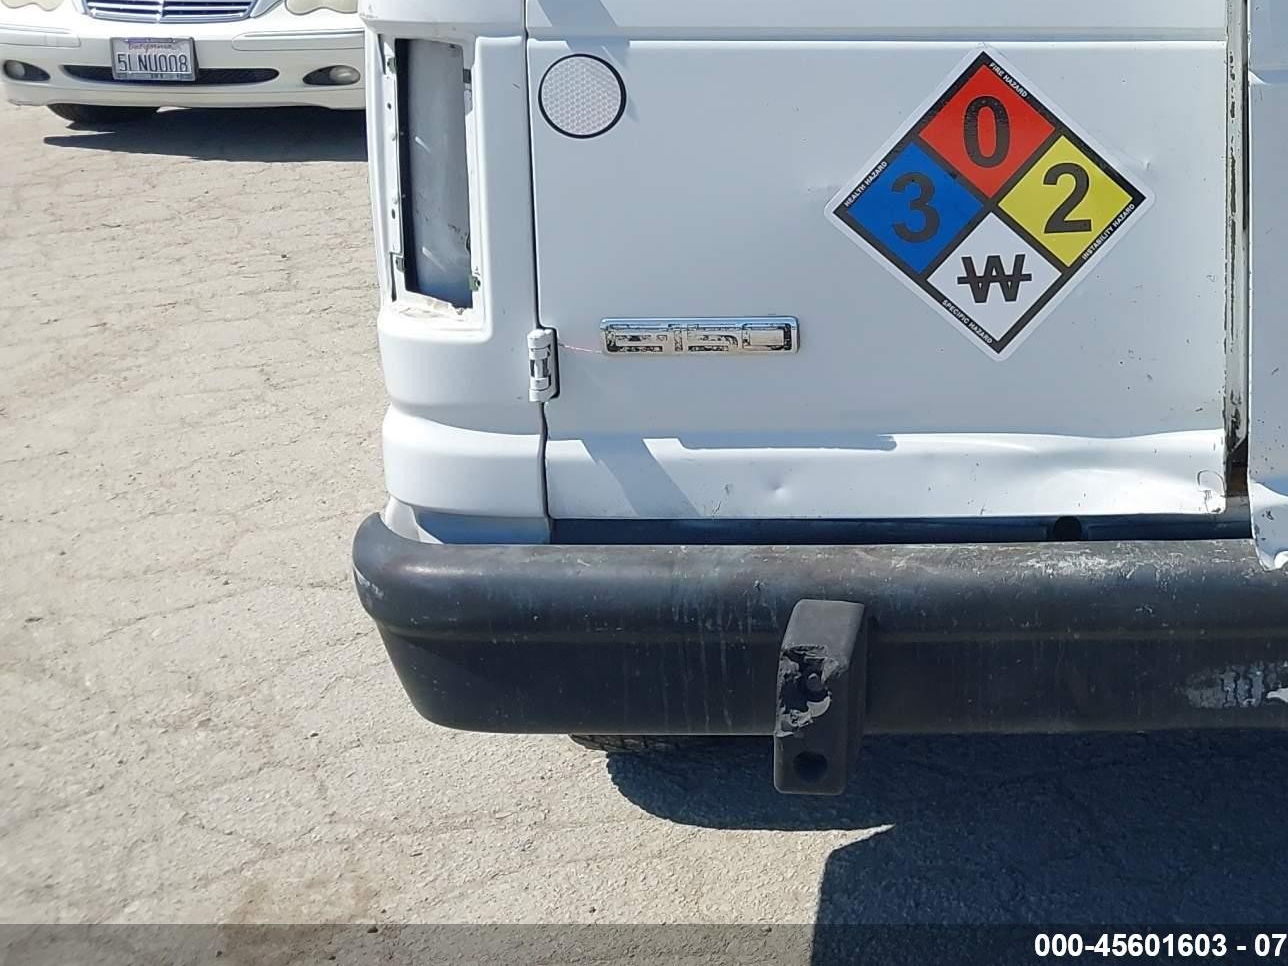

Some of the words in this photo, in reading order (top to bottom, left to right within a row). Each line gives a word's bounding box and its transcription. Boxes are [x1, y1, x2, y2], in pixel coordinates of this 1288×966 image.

[1002, 74, 1028, 98] HAZARD
[963, 96, 1011, 168] 0
[843, 183, 866, 207] HEALTH
[864, 161, 888, 185] HAZARD
[891, 172, 940, 244] 3
[1043, 163, 1092, 234] 2
[1081, 225, 1114, 260] INSTABILITY
[1112, 203, 1135, 227] HAZARD
[941, 299, 970, 324] SPECIFIC
[968, 321, 993, 344] HAZARD
